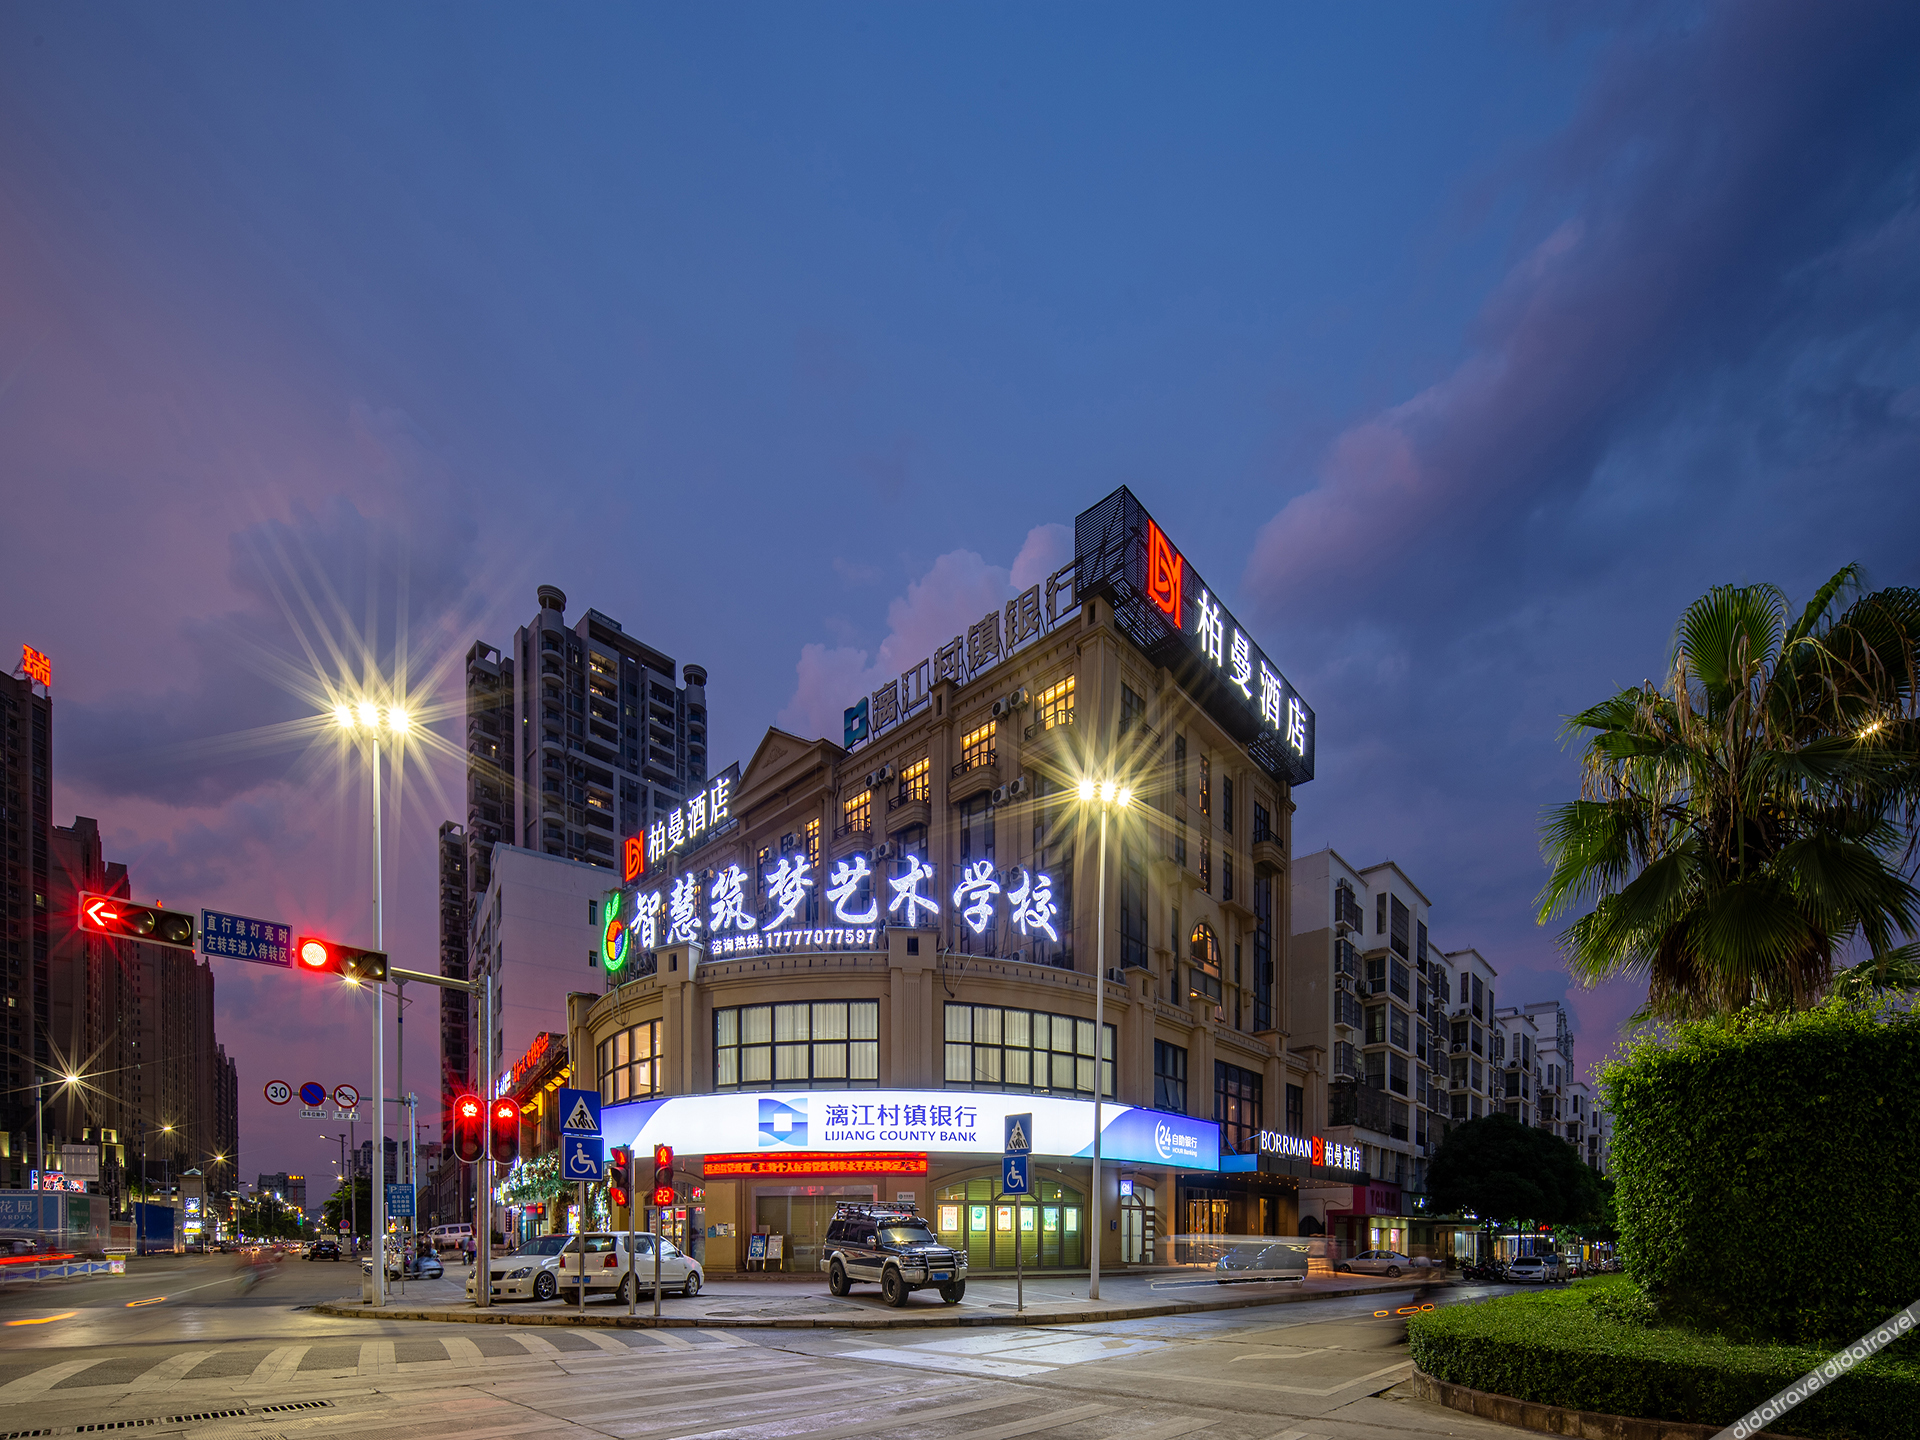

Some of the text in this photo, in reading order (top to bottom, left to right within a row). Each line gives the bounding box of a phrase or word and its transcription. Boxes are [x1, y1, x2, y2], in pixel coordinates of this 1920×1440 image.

[23, 644, 51, 687] 瑞
[1198, 588, 1306, 757] 柏曼酒店
[648, 778, 730, 863] 柏曼酒店
[630, 855, 1058, 948] 智慧筑梦艺术学校
[207, 914, 288, 944] 直行绿灯亮时
[207, 934, 288, 962] 左转车进入待转区
[271, 1086, 288, 1099] 30
[825, 1104, 977, 1128] 漓江村镇银行
[825, 1131, 977, 1142] LIJIANG COUNTY BANK
[1159, 1125, 1171, 1146] 24
[1172, 1133, 1198, 1149] 自助银行
[1261, 1130, 1312, 1158] BORRMAN
[1325, 1141, 1360, 1171] 柏曼酒店
[657, 1190, 669, 1202] 22
